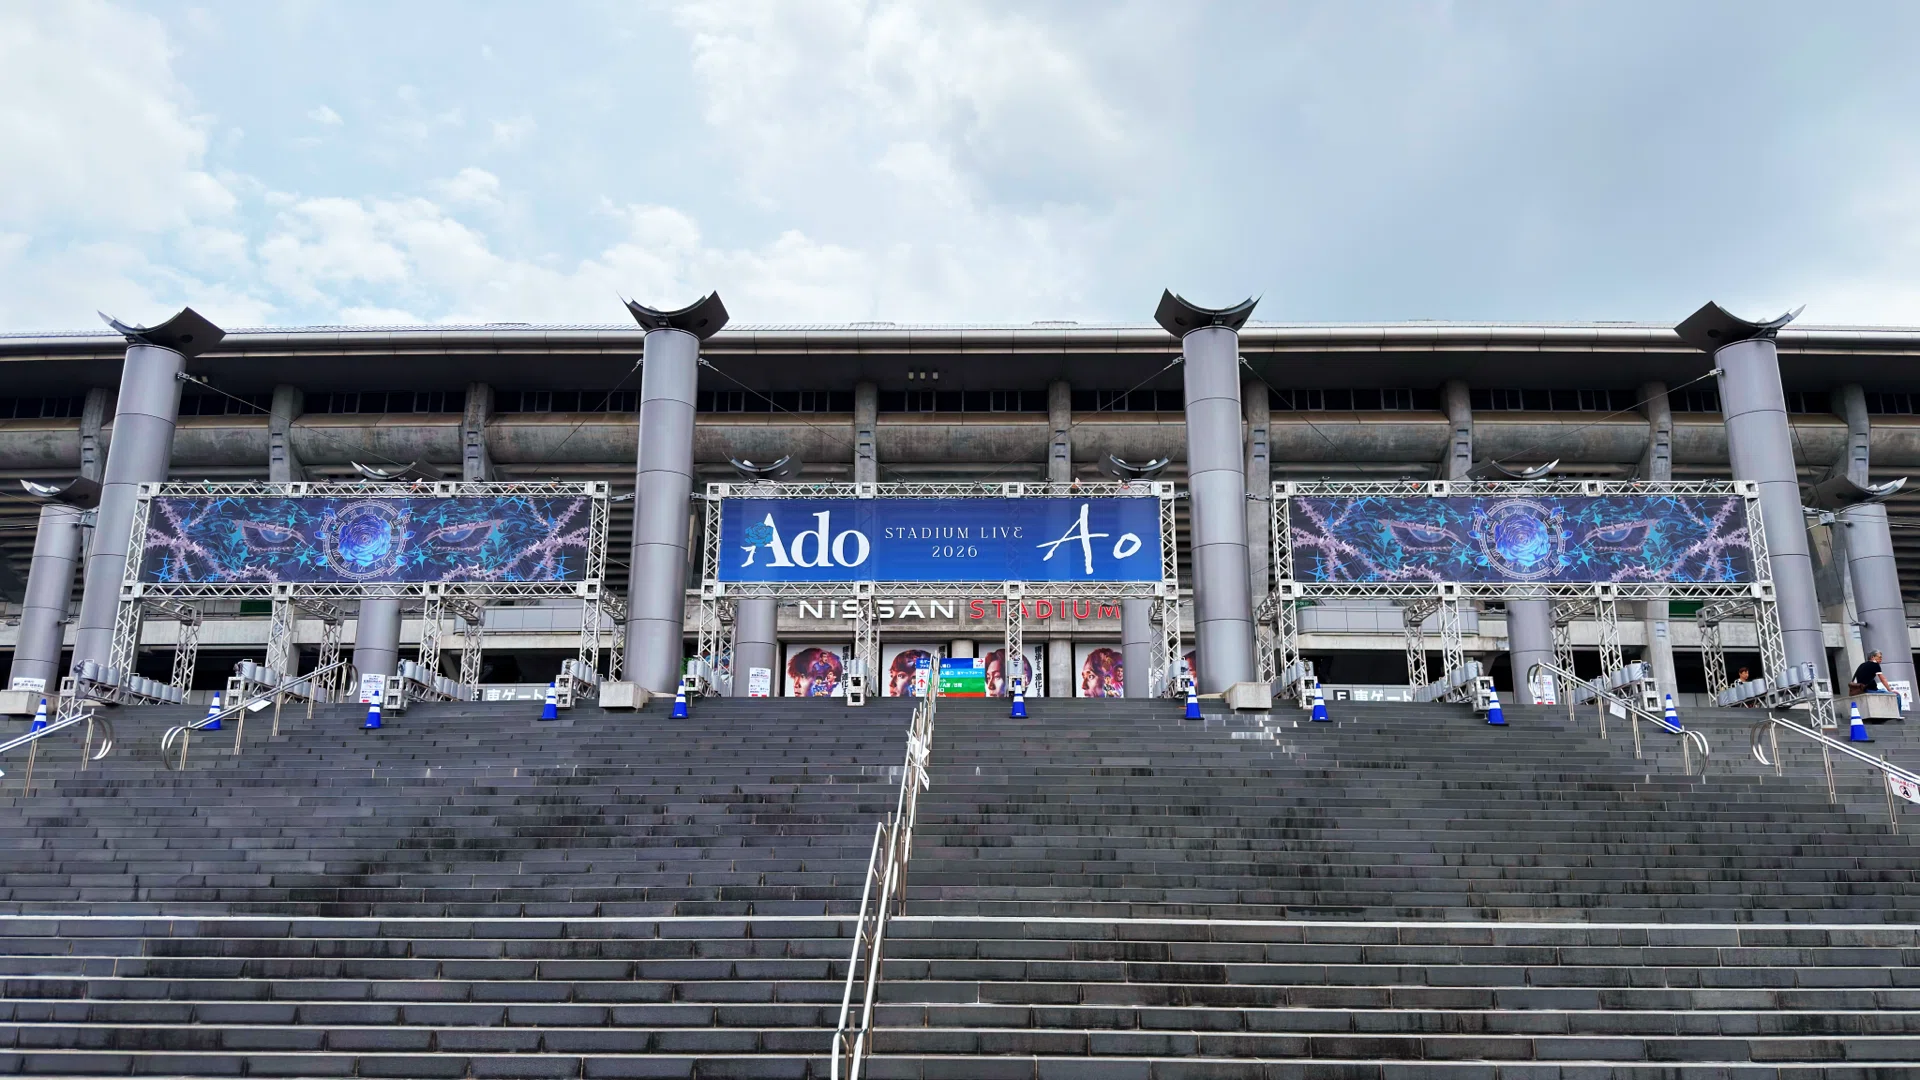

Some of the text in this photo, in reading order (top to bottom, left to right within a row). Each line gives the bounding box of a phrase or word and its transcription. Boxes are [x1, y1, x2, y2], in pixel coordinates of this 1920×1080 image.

[740, 510, 870, 568] Ado
[885, 526, 1023, 539] STADIUM LIVE
[1036, 503, 1142, 575] Ao
[932, 545, 978, 558] 2026
[487, 688, 544, 701] 東ゲート
[1353, 689, 1413, 702] 東ゲート
